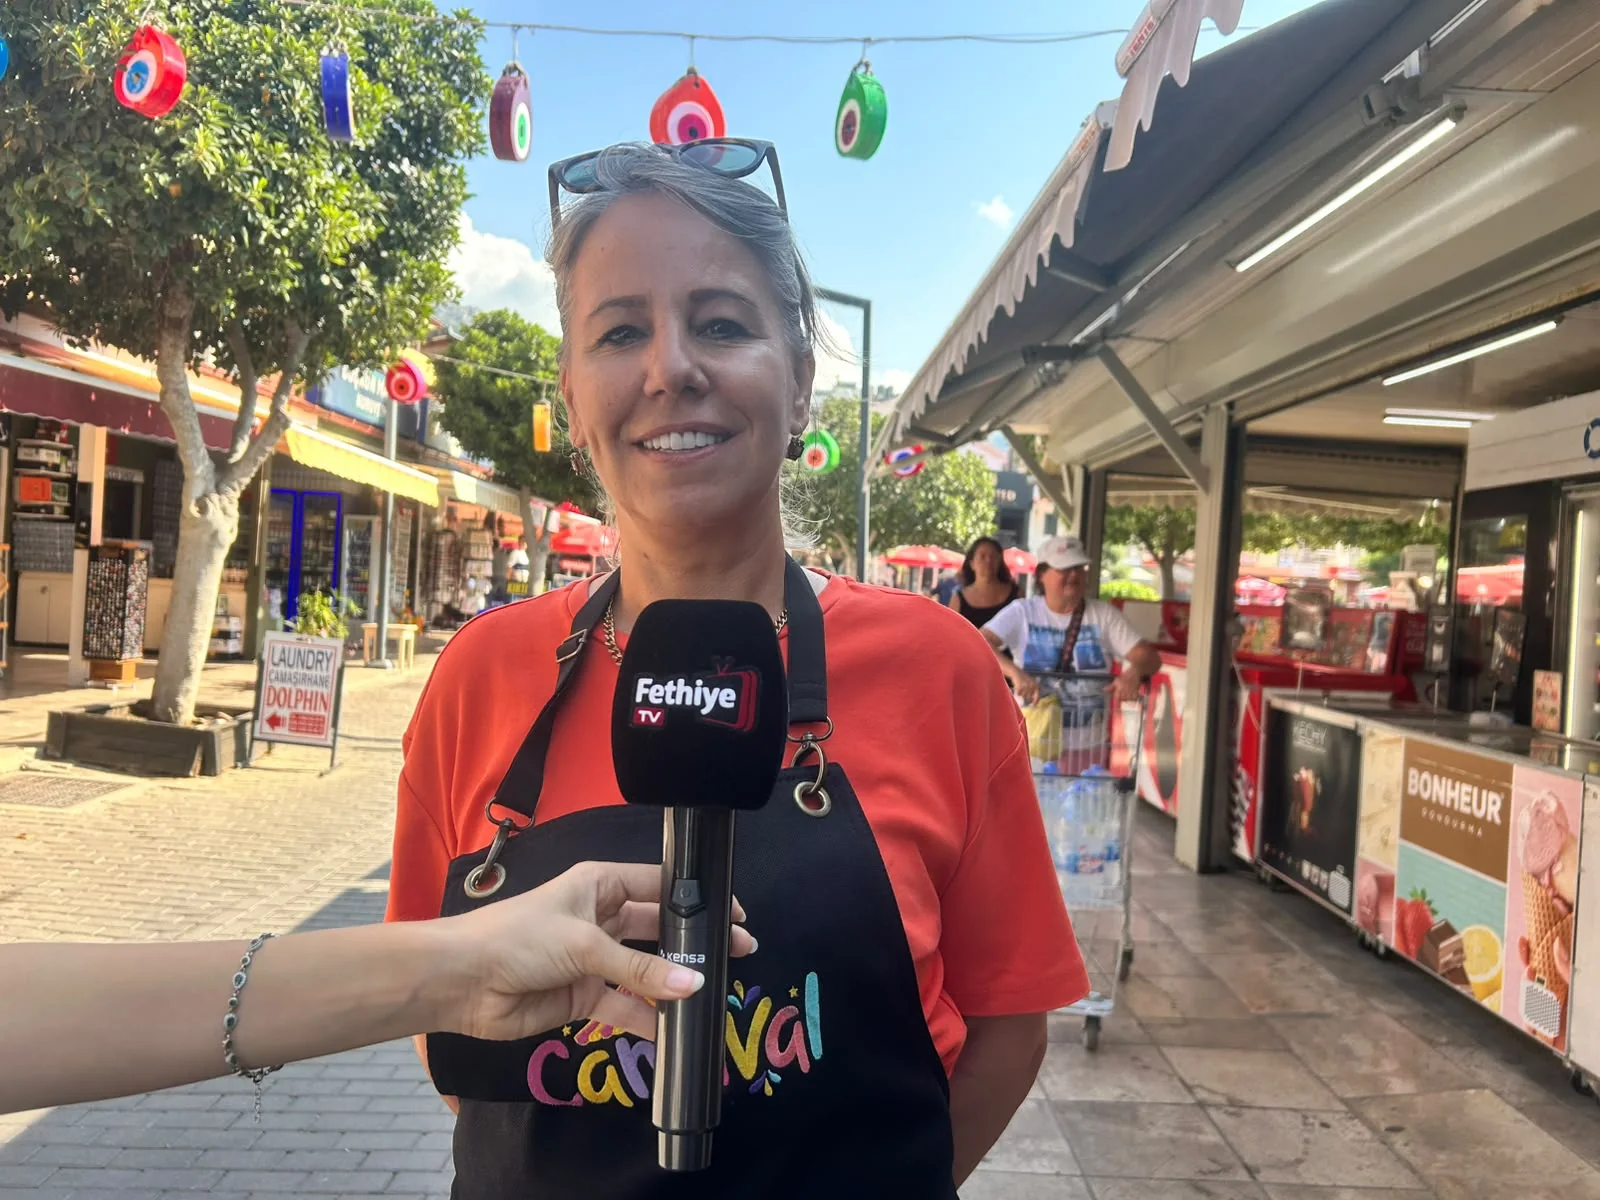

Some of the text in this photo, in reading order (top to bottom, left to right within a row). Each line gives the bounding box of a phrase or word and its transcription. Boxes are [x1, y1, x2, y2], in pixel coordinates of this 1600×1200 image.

[271, 645, 333, 673] LAUNDRY
[266, 686, 329, 712] DOLPHIN
[635, 677, 737, 716] Fethiye
[638, 709, 662, 723] TV
[1407, 767, 1503, 826] BONHEUR
